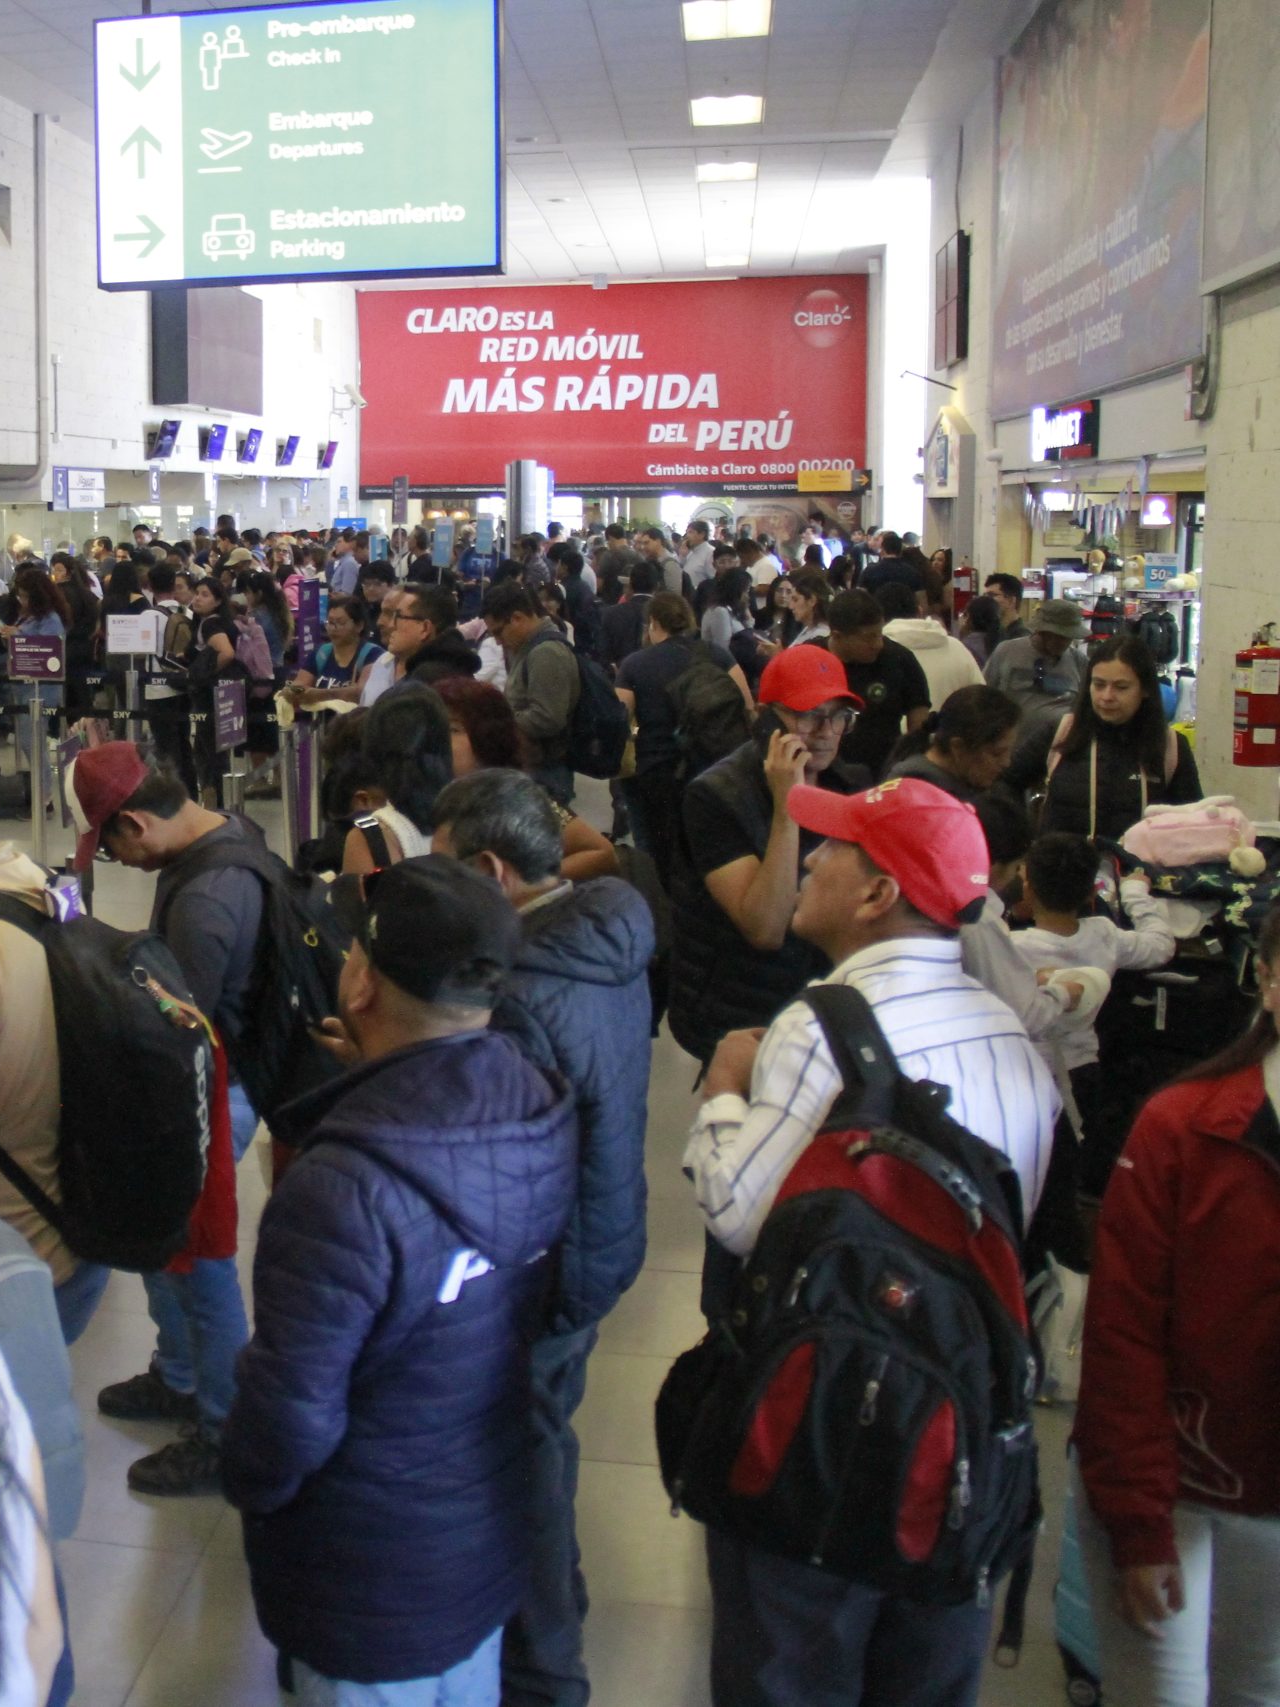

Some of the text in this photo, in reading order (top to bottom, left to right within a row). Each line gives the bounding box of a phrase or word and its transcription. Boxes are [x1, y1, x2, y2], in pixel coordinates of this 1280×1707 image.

[267, 14, 416, 38] Pre-embarque
[267, 47, 341, 67] Check in
[269, 109, 374, 132] Embarque
[270, 139, 364, 161] Departures
[270, 203, 466, 231] Estacionamiento
[271, 238, 346, 260] Parking
[407, 306, 554, 334] CLARO ES LA
[794, 311, 843, 327] Claro
[480, 328, 644, 363] RED MÓVIL
[442, 365, 719, 414] MÁS RÁPIDA
[648, 410, 793, 451] DEL PERÚ
[646, 463, 709, 476] Cámbiate
[711, 466, 719, 475] a
[721, 463, 756, 475] Claro
[760, 463, 795, 474] 0800
[57, 473, 64, 496] 5
[152, 472, 158, 491] 6
[113, 710, 131, 719] SKY
[188, 713, 207, 722] SKY
